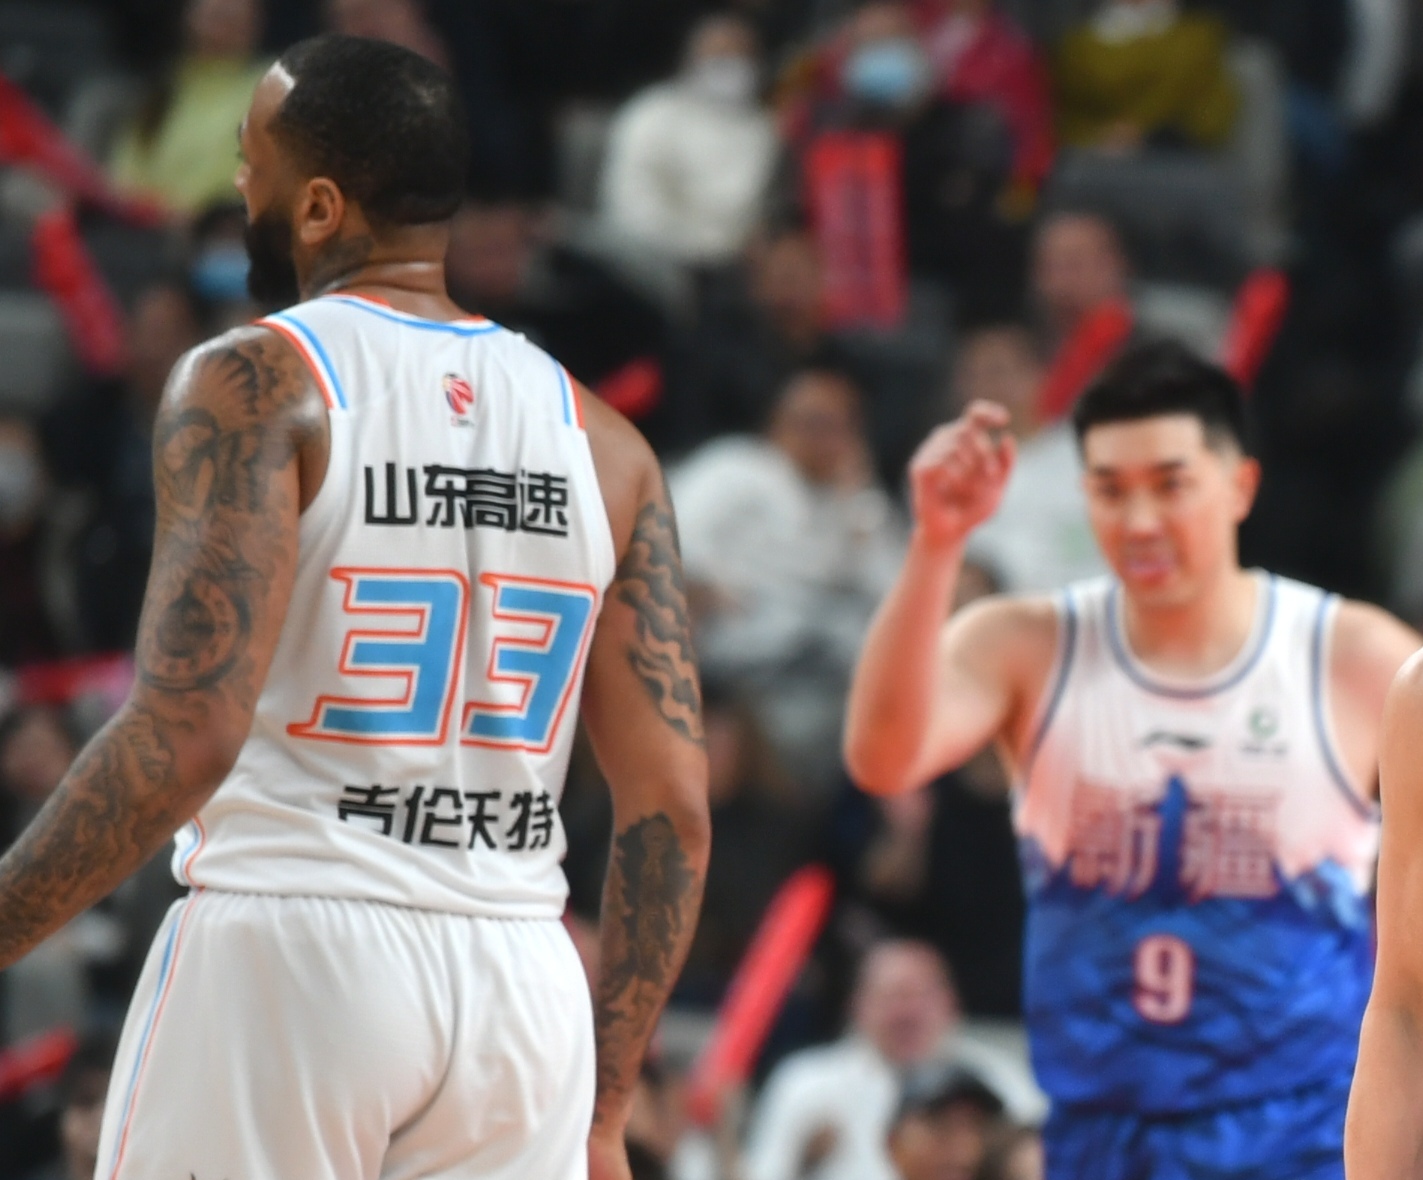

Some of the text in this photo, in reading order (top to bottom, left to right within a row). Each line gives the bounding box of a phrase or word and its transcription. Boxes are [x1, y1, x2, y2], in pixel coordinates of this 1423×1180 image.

[364, 461, 569, 537] 山东高速
[286, 566, 599, 755] 33
[1131, 931, 1195, 1025] 9
